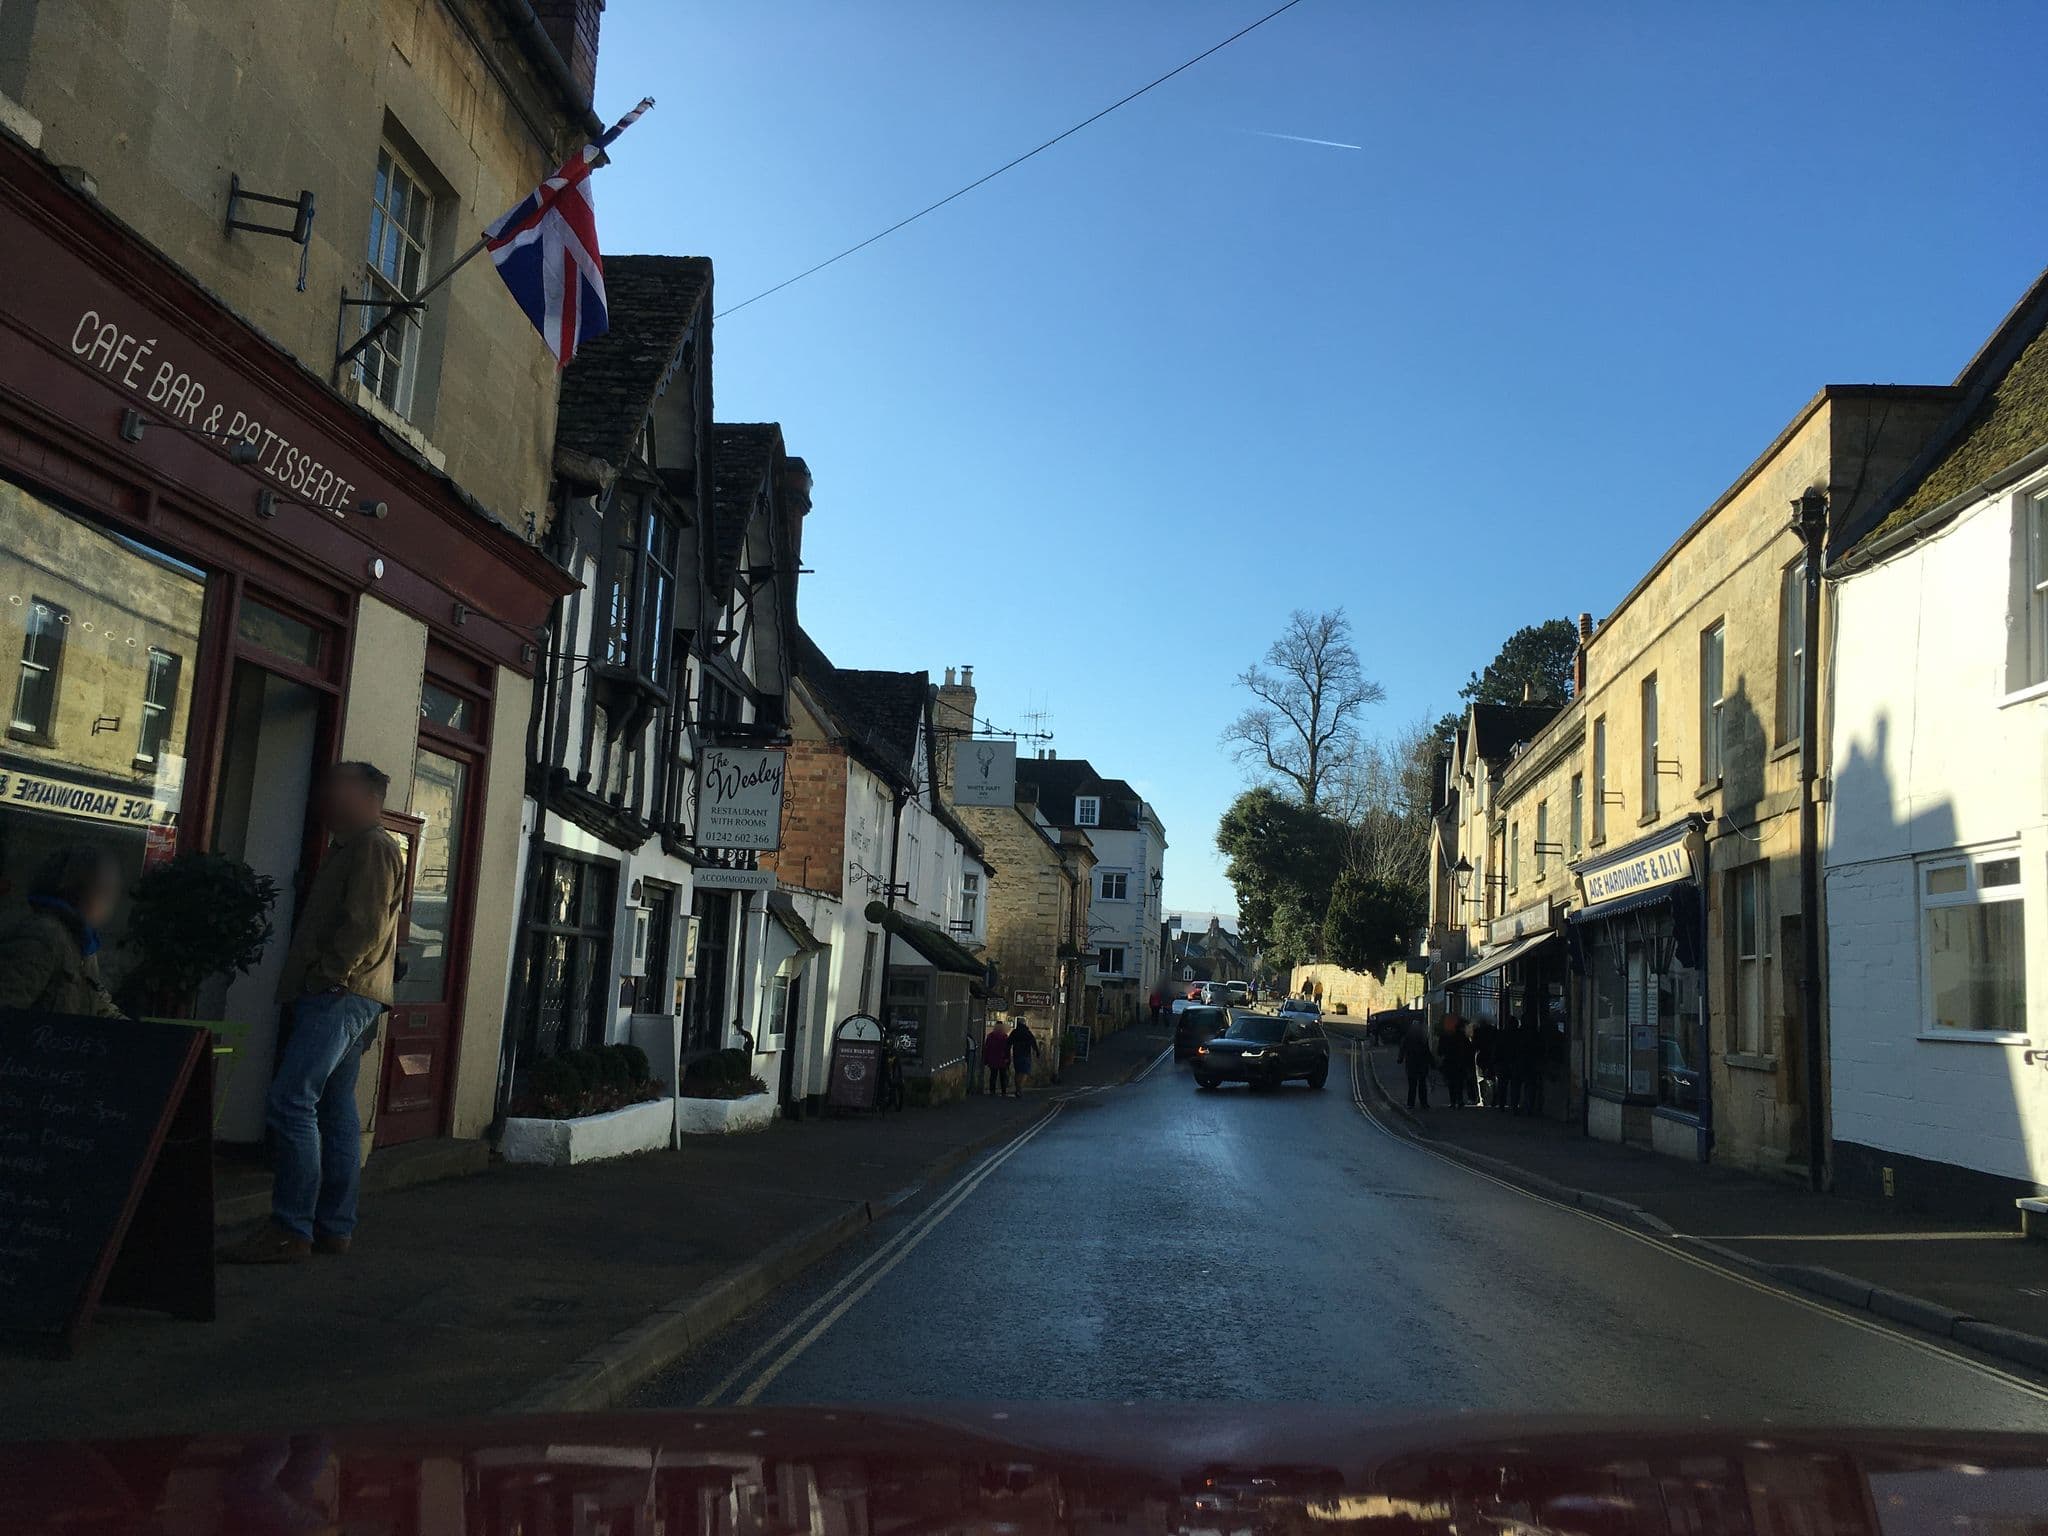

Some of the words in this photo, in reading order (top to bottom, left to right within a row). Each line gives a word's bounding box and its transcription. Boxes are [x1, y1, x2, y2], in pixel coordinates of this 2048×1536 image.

[71, 310, 158, 390] CAFÉ
[146, 361, 205, 425] BAR
[202, 404, 224, 440] &
[222, 411, 356, 519] PATISSERIE
[707, 752, 729, 770] The
[706, 757, 781, 804] Wesley
[711, 807, 768, 817] RESTAURANT
[710, 817, 735, 826] WITH
[736, 818, 767, 828] ROOMS
[706, 832, 732, 842] 01242
[735, 834, 751, 843] 602
[701, 873, 768, 885] ACCOMMODATION
[1590, 877, 1604, 899] ACE
[1603, 861, 1650, 894] HARDWARE
[1649, 858, 1660, 880] &
